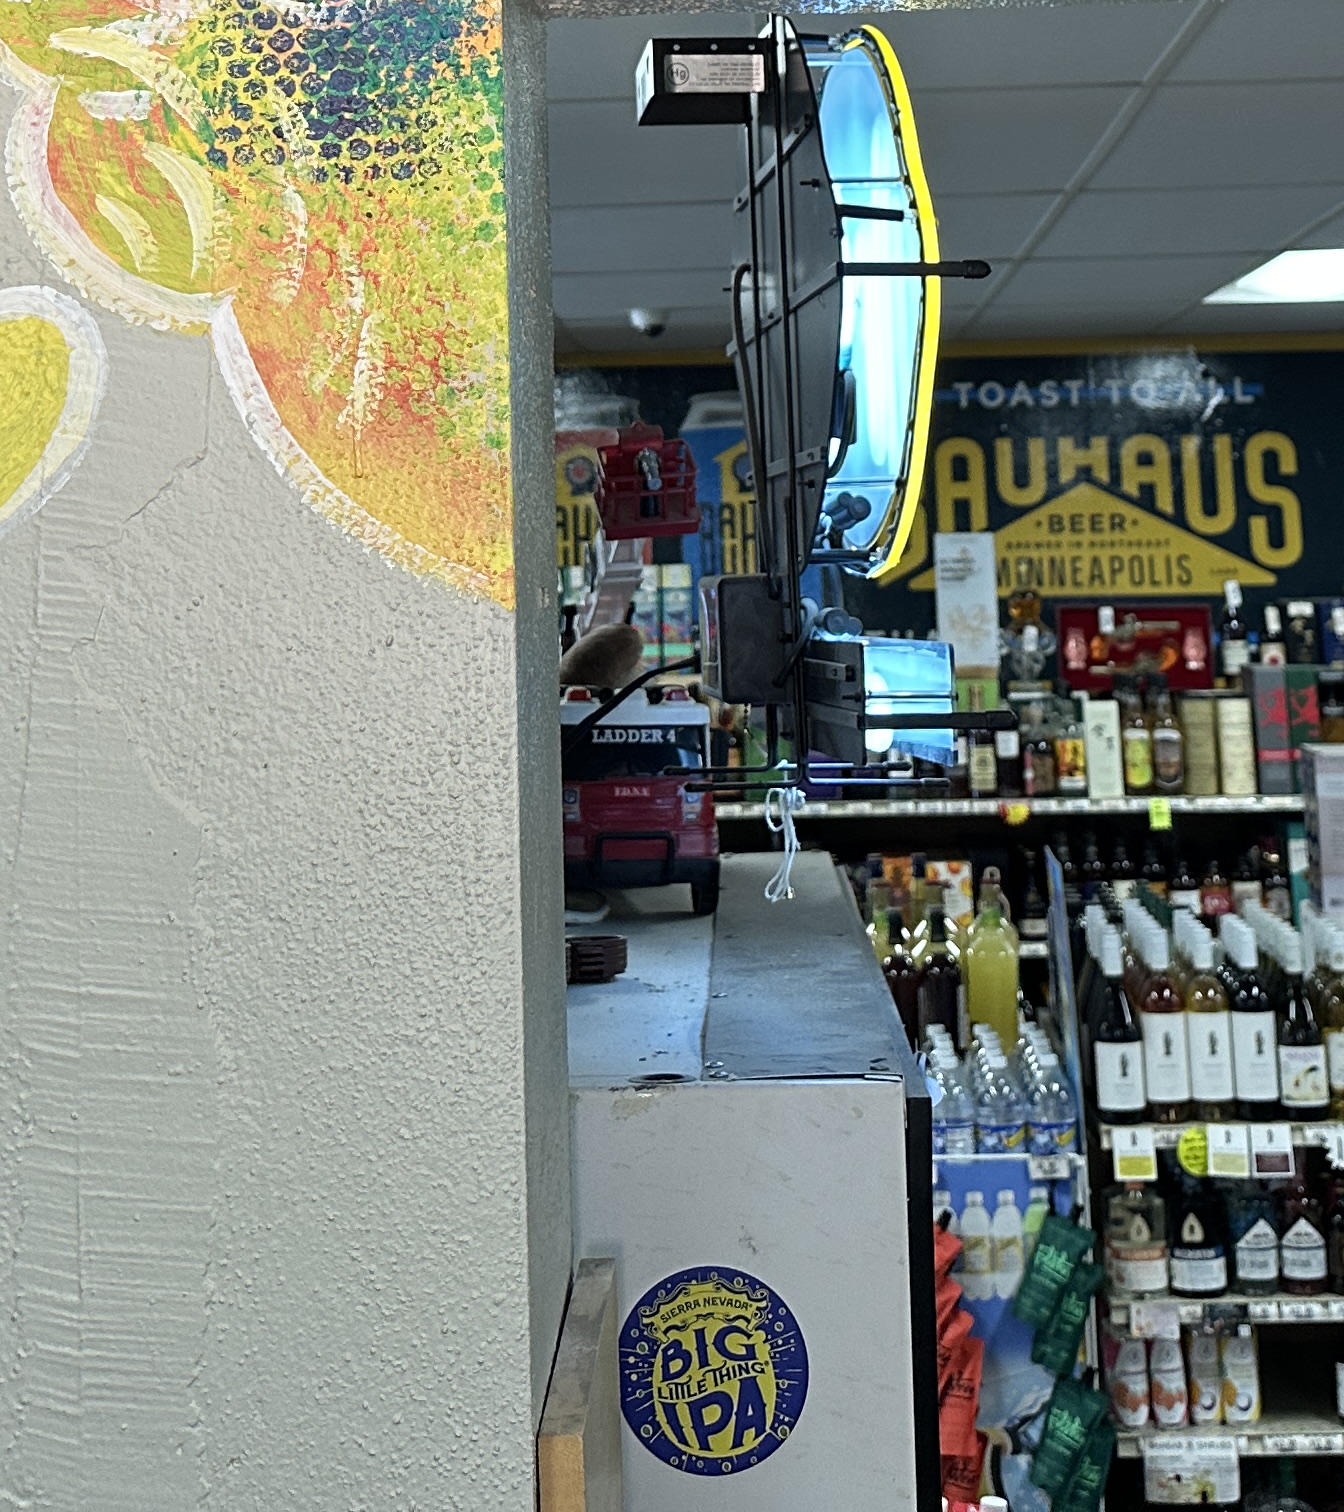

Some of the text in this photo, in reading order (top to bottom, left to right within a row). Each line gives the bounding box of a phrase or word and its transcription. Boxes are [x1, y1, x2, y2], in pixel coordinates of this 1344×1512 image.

[952, 379, 1083, 408] TOAST
[1106, 377, 1162, 409] TO
[1047, 513, 1128, 534] BEER
[591, 728, 677, 744] LADDER 4
[660, 1296, 750, 1324] SIERRA NEVADA
[660, 1324, 759, 1383] BIG
[657, 1360, 766, 1401] LITTLE THING
[657, 1376, 767, 1452] IPA
